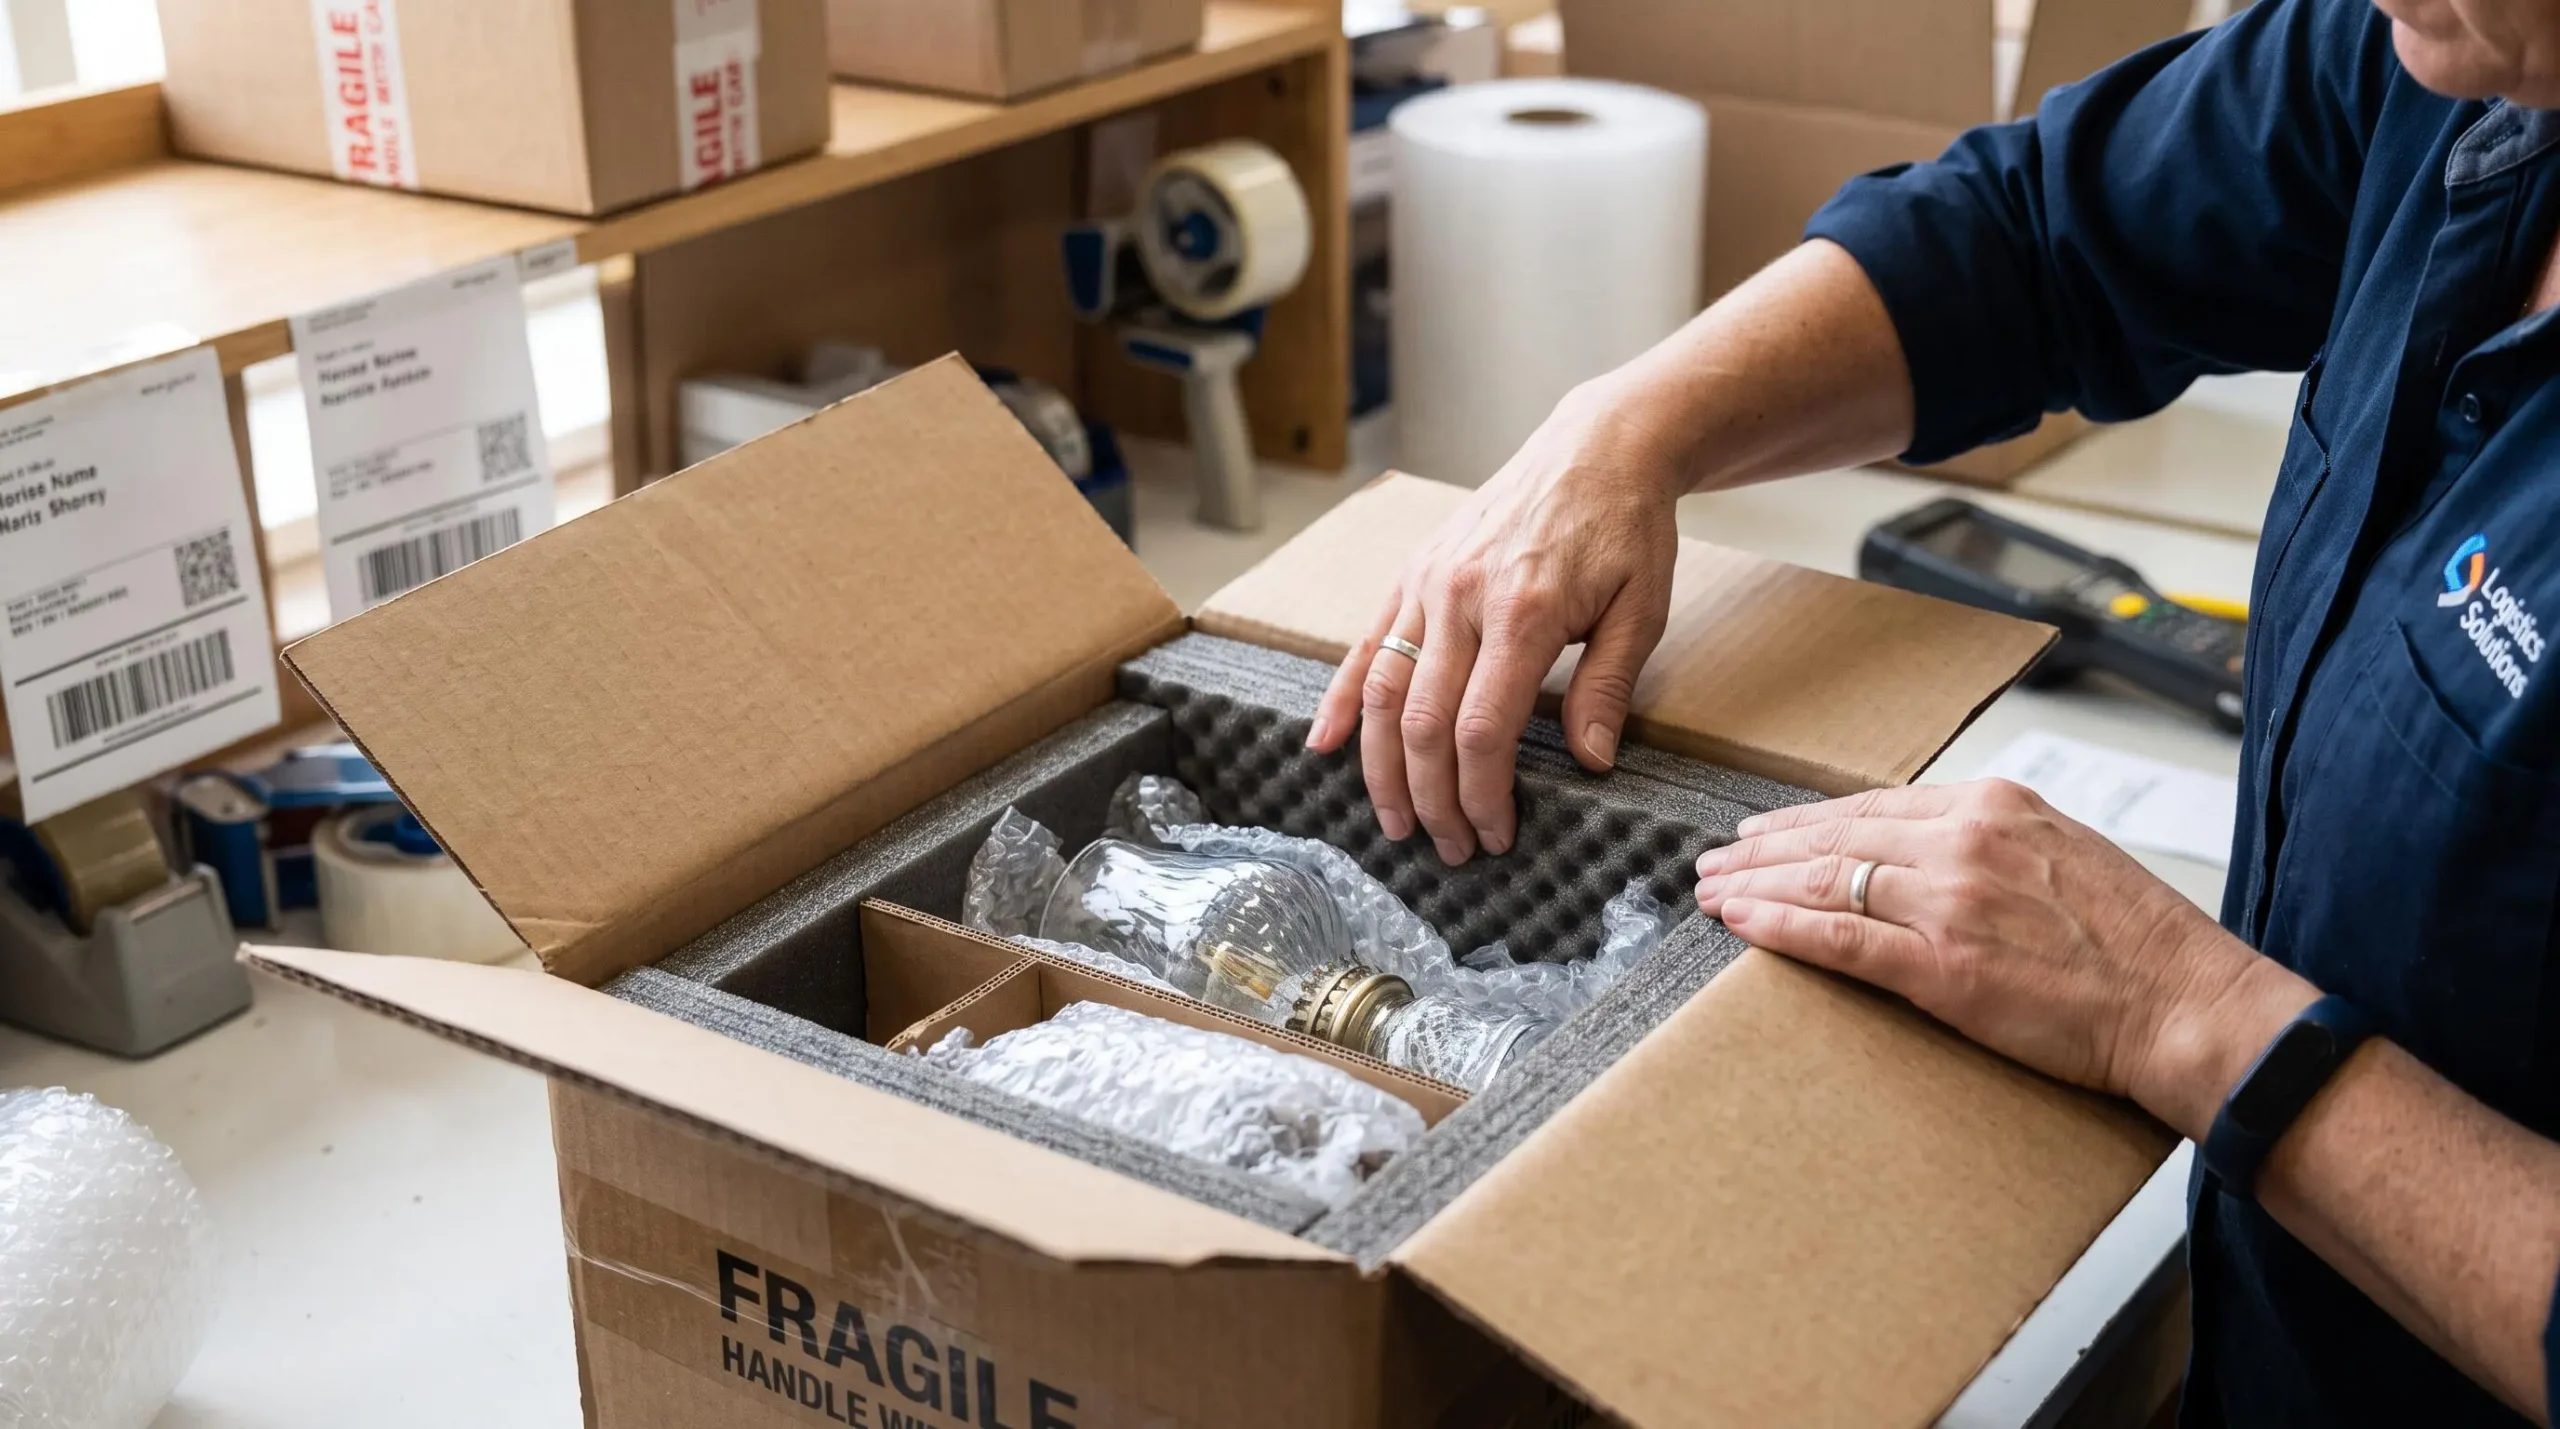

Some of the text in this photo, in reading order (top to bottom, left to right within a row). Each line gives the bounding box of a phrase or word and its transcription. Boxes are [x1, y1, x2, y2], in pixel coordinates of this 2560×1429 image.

[328, 11, 377, 176] RAGILE
[2460, 600, 2528, 699] Solutions
[2481, 566, 2546, 663] Logistics
[716, 1248, 1079, 1429] FRAGILE
[721, 1334, 868, 1429] HANDLE
